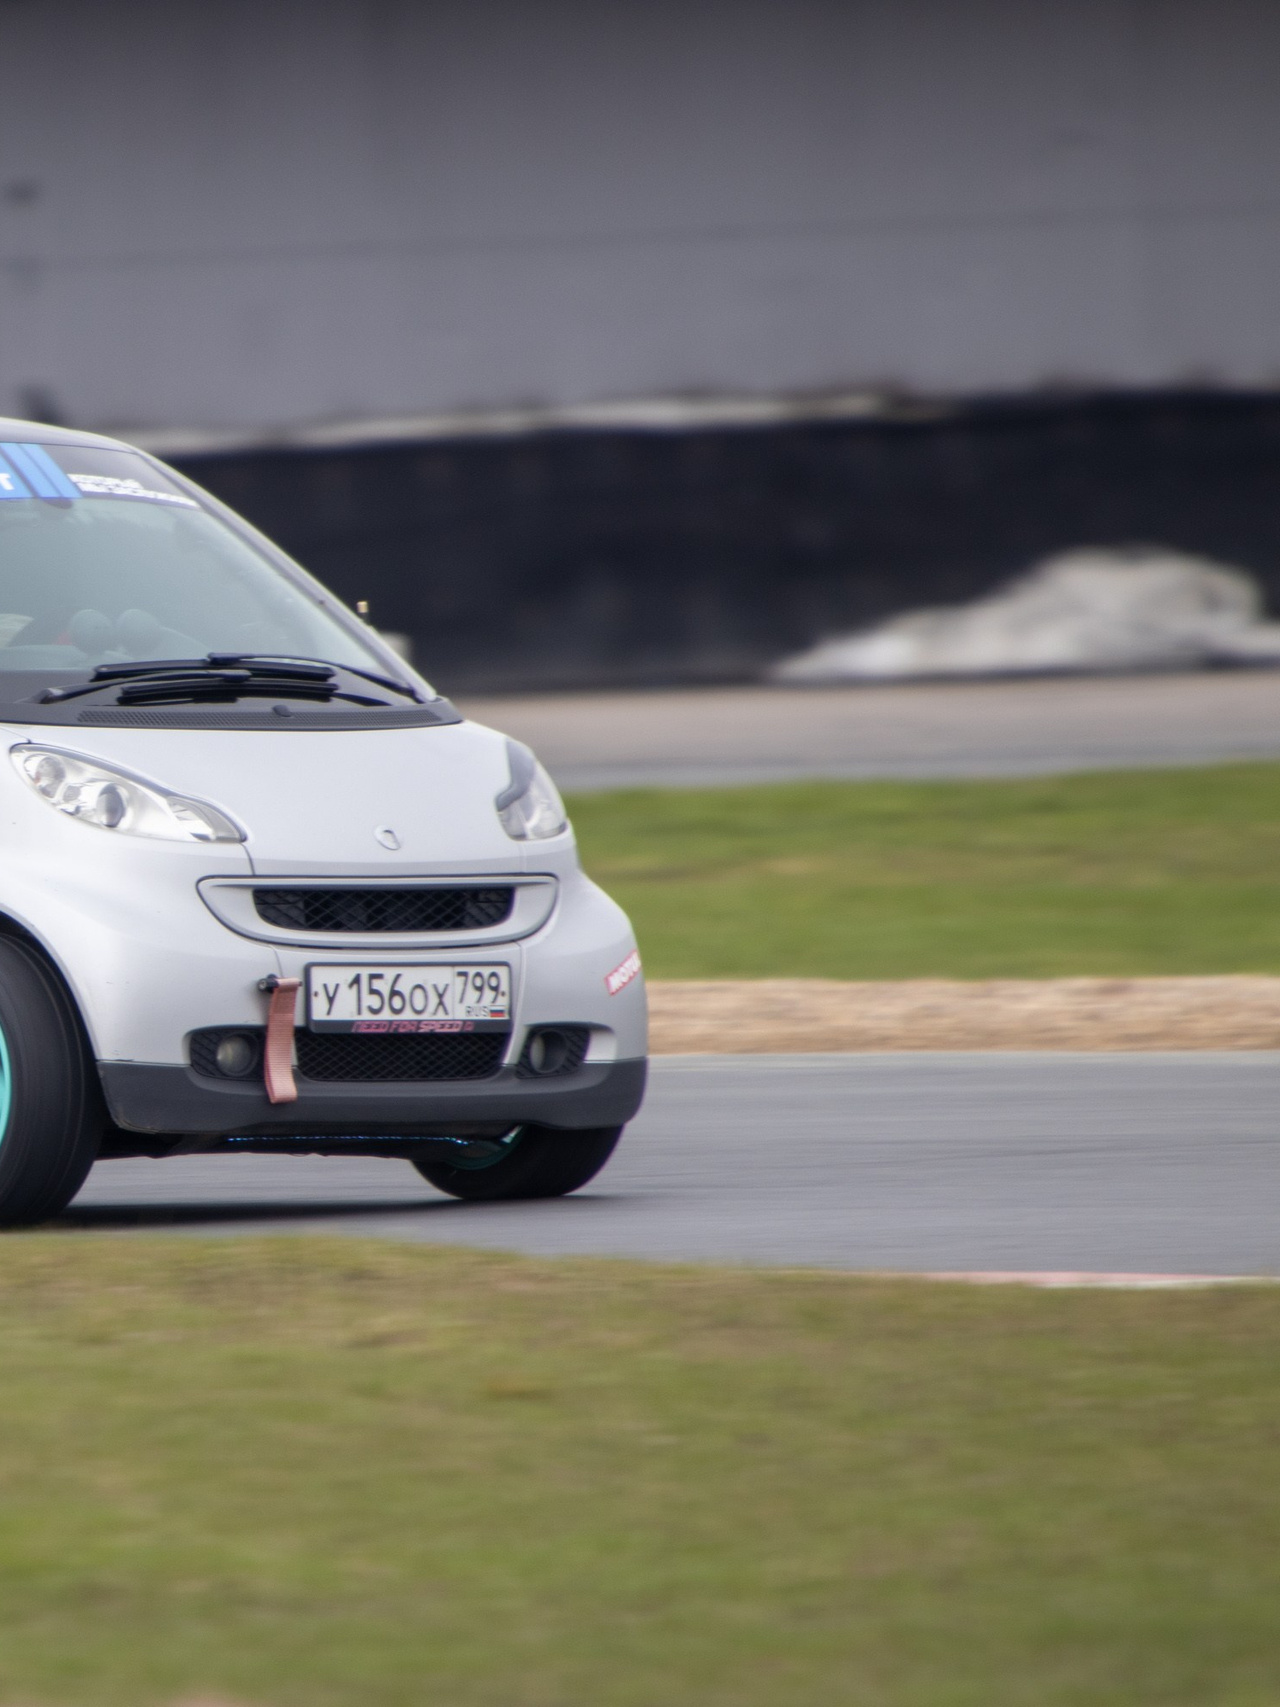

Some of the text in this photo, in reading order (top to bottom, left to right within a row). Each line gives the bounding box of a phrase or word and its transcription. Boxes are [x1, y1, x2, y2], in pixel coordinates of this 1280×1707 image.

[607, 951, 641, 993] MOTU
[456, 971, 501, 1004] 799
[465, 1005, 488, 1018] RUS
[418, 1021, 463, 1033] SPEED
